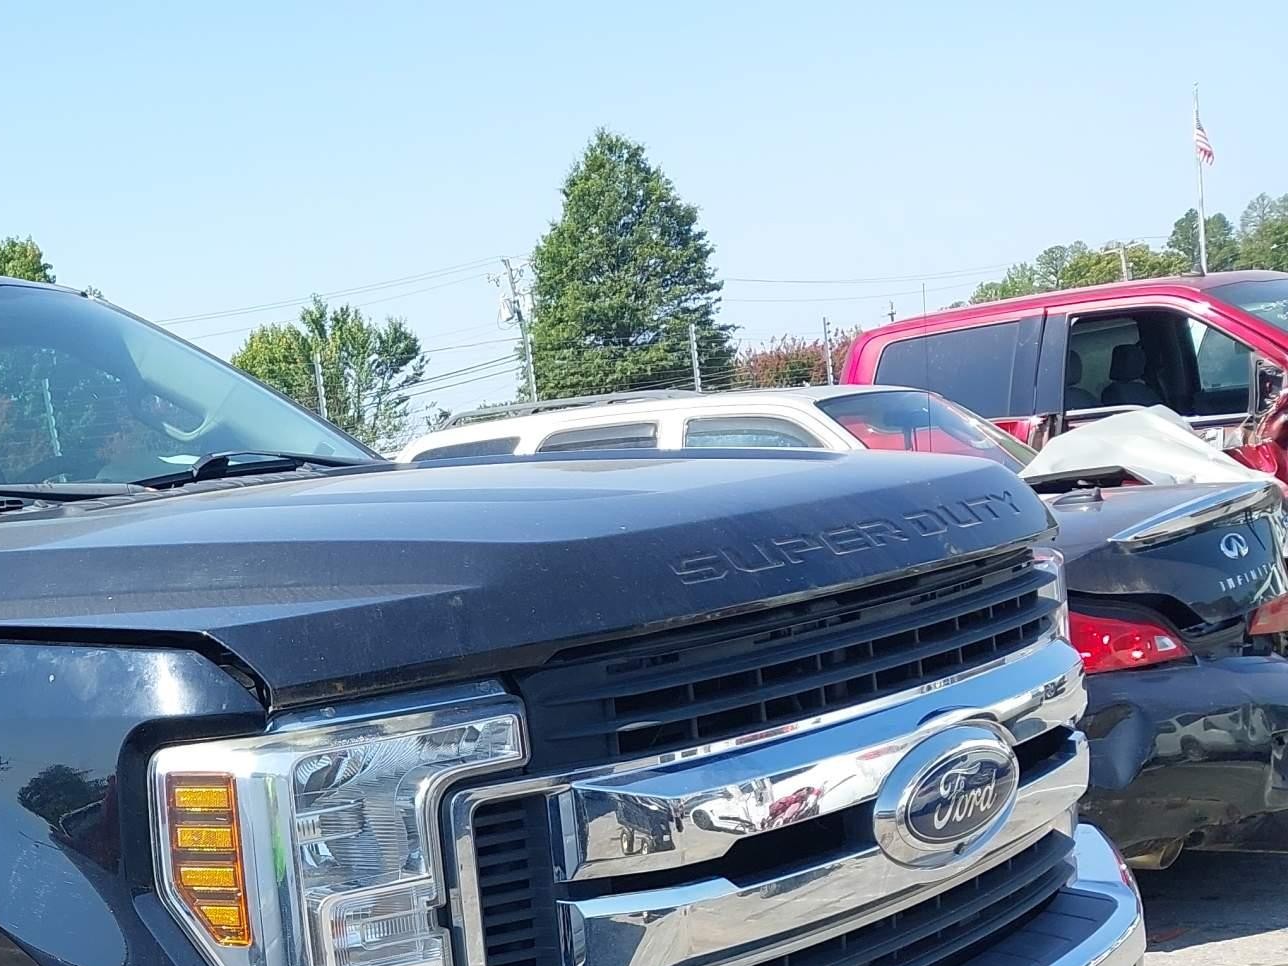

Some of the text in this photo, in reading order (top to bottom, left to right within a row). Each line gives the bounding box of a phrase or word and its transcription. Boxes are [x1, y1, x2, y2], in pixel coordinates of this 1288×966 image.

[668, 489, 1021, 585] SUPER DUTY
[933, 761, 998, 830] Ford
